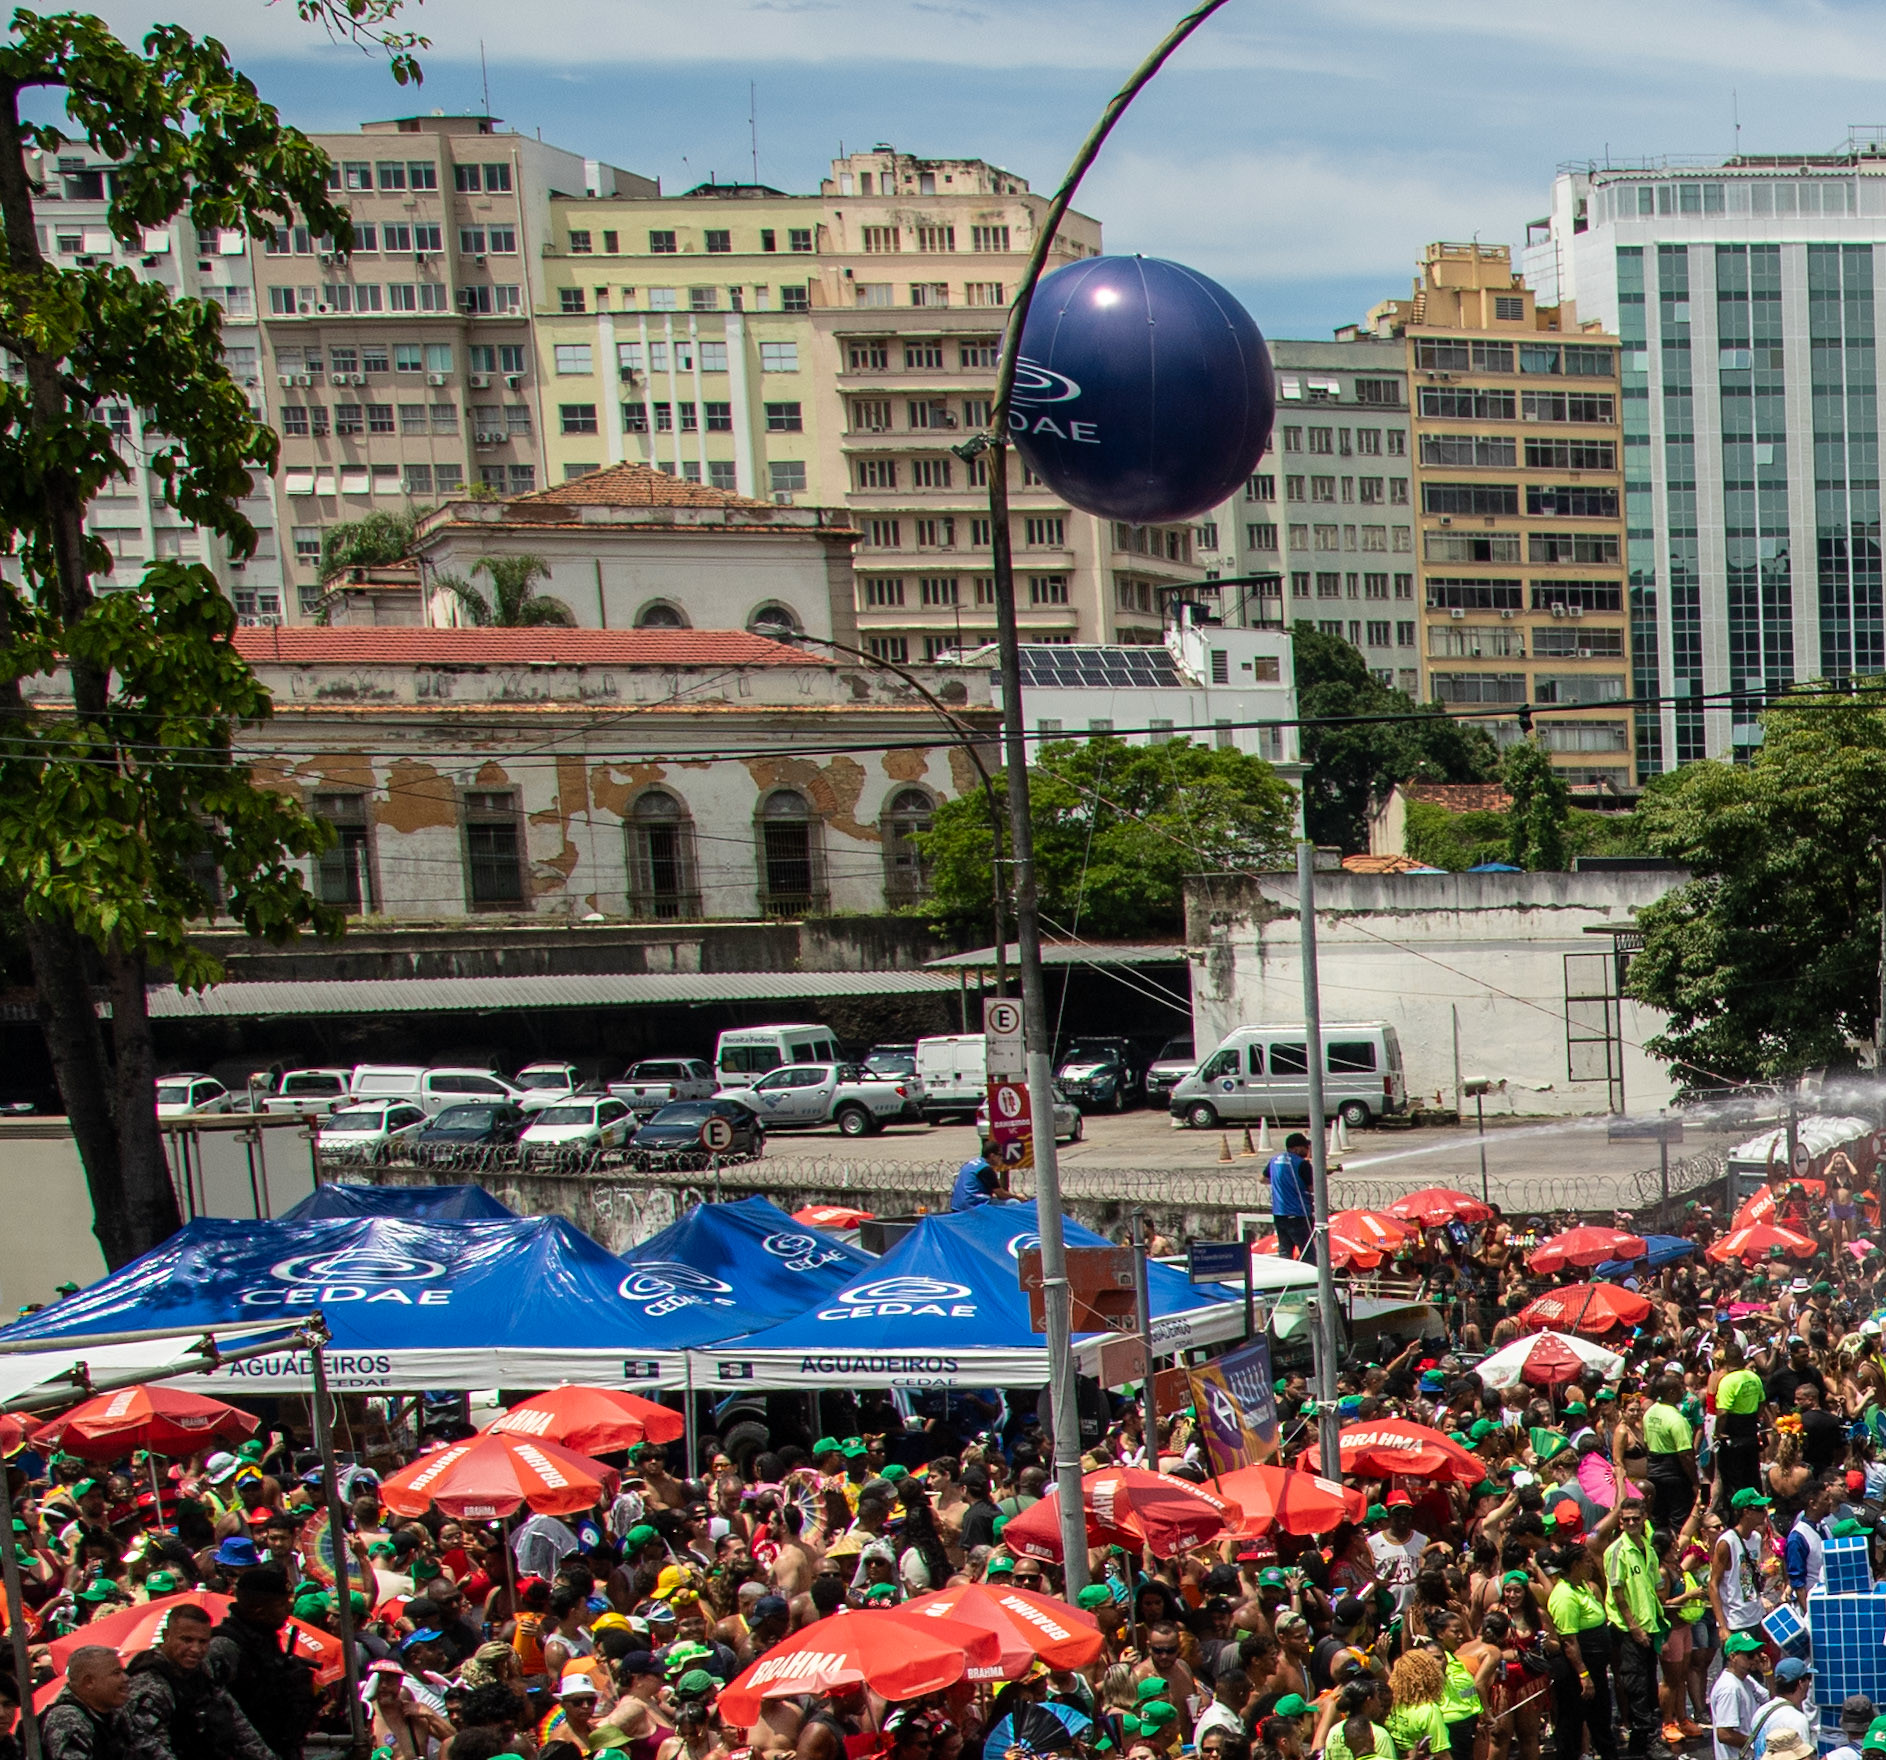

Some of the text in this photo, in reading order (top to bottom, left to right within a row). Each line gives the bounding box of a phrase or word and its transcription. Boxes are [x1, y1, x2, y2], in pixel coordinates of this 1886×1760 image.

[1000, 1010, 1010, 1028] E
[710, 1124, 723, 1145] E
[241, 1286, 453, 1306] CEDAE
[818, 1303, 976, 1320] CEDAE
[801, 1356, 958, 1373] AGUADEIROS
[892, 1378, 958, 1386] CEDAE
[1340, 1429, 1426, 1453] BRAHMA
[407, 1446, 470, 1491] BRAHMA
[514, 1443, 568, 1489] BRAHMA
[999, 1597, 1071, 1639] BRAHMA
[748, 1651, 847, 1684] BRAHMA
[967, 1666, 1004, 1680] BRAHMA
